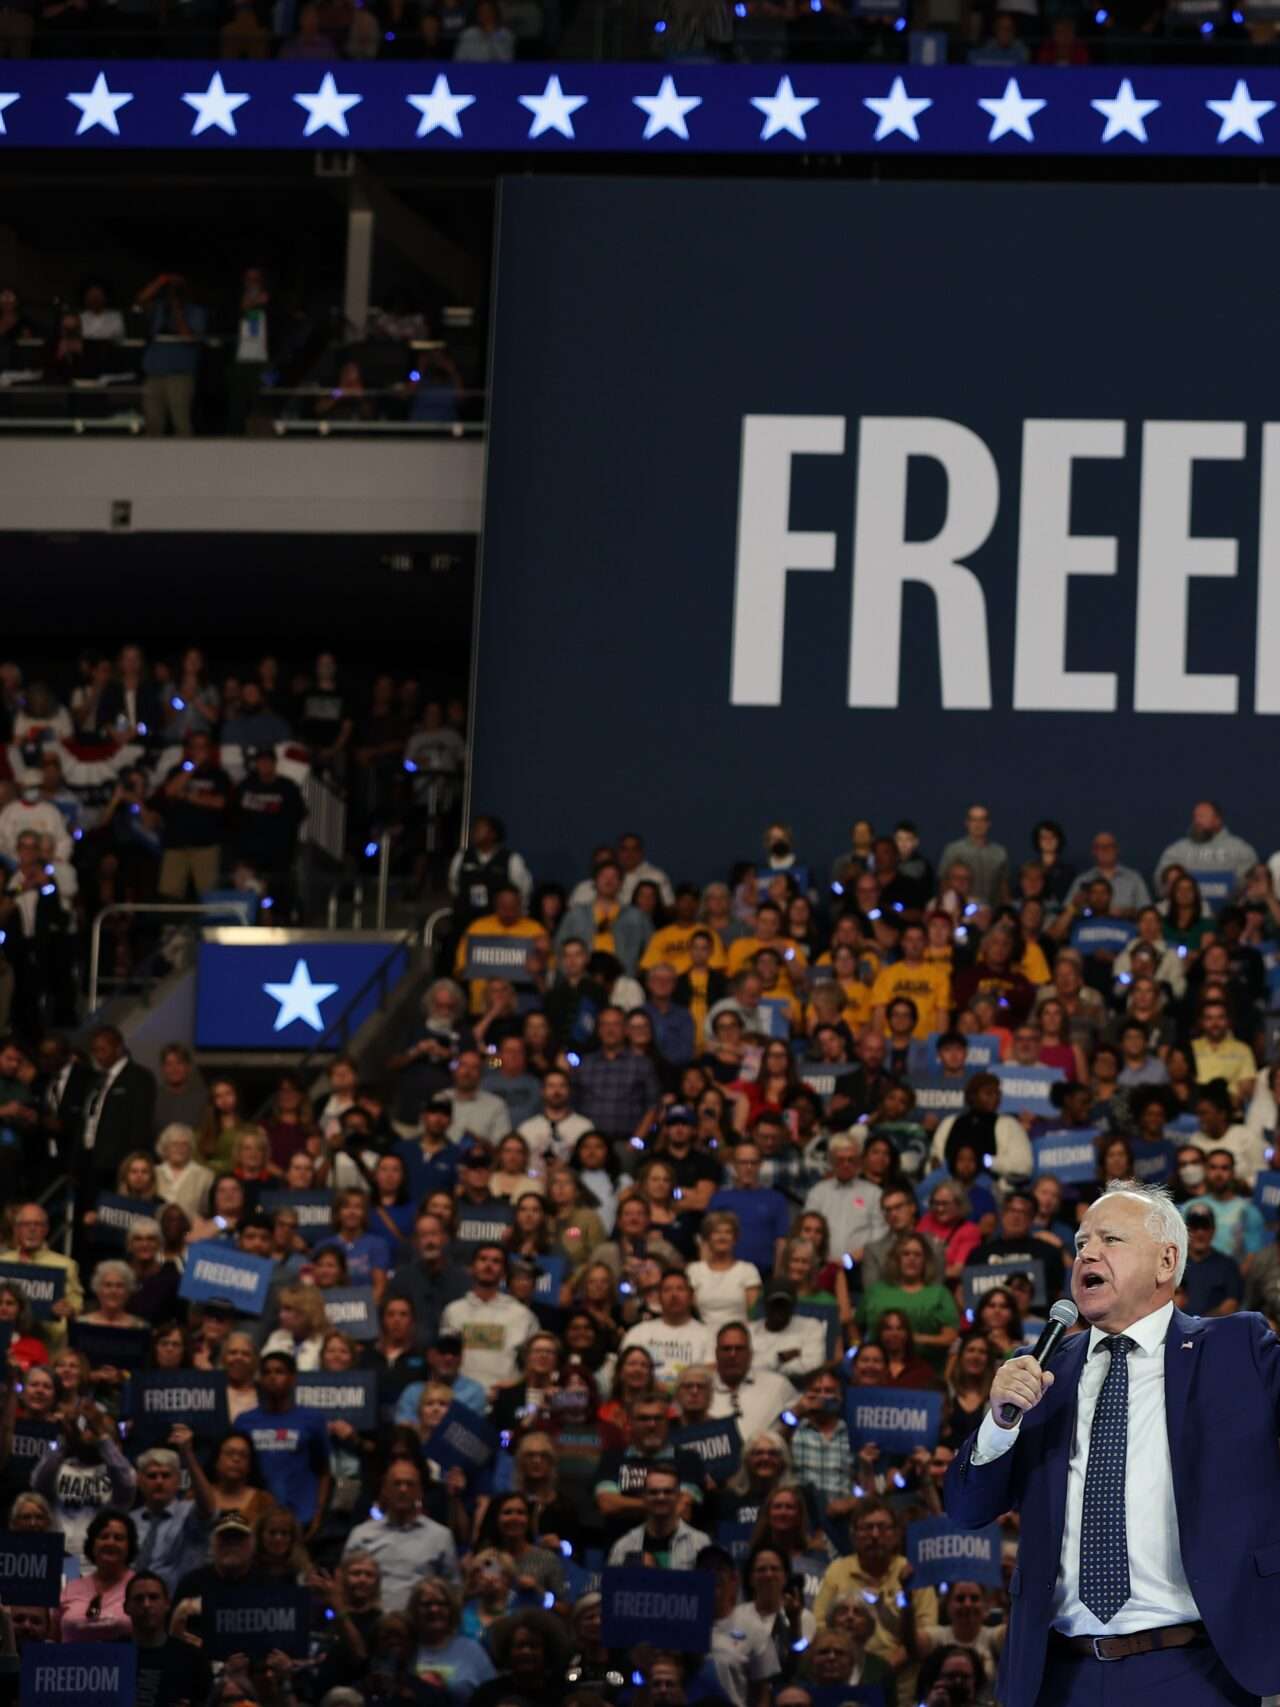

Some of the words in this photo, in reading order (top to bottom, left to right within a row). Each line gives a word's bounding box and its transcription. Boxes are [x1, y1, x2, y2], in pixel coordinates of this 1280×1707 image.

[144, 1387, 216, 1412] FREEDOM
[295, 1385, 365, 1409] FREEDOM
[856, 1406, 928, 1433] FREEDOM
[916, 1535, 990, 1563] FREEDOM
[612, 1590, 698, 1623] FREEDOM
[214, 1607, 297, 1634] FREEDOM
[34, 1665, 119, 1693] FREEDOM
